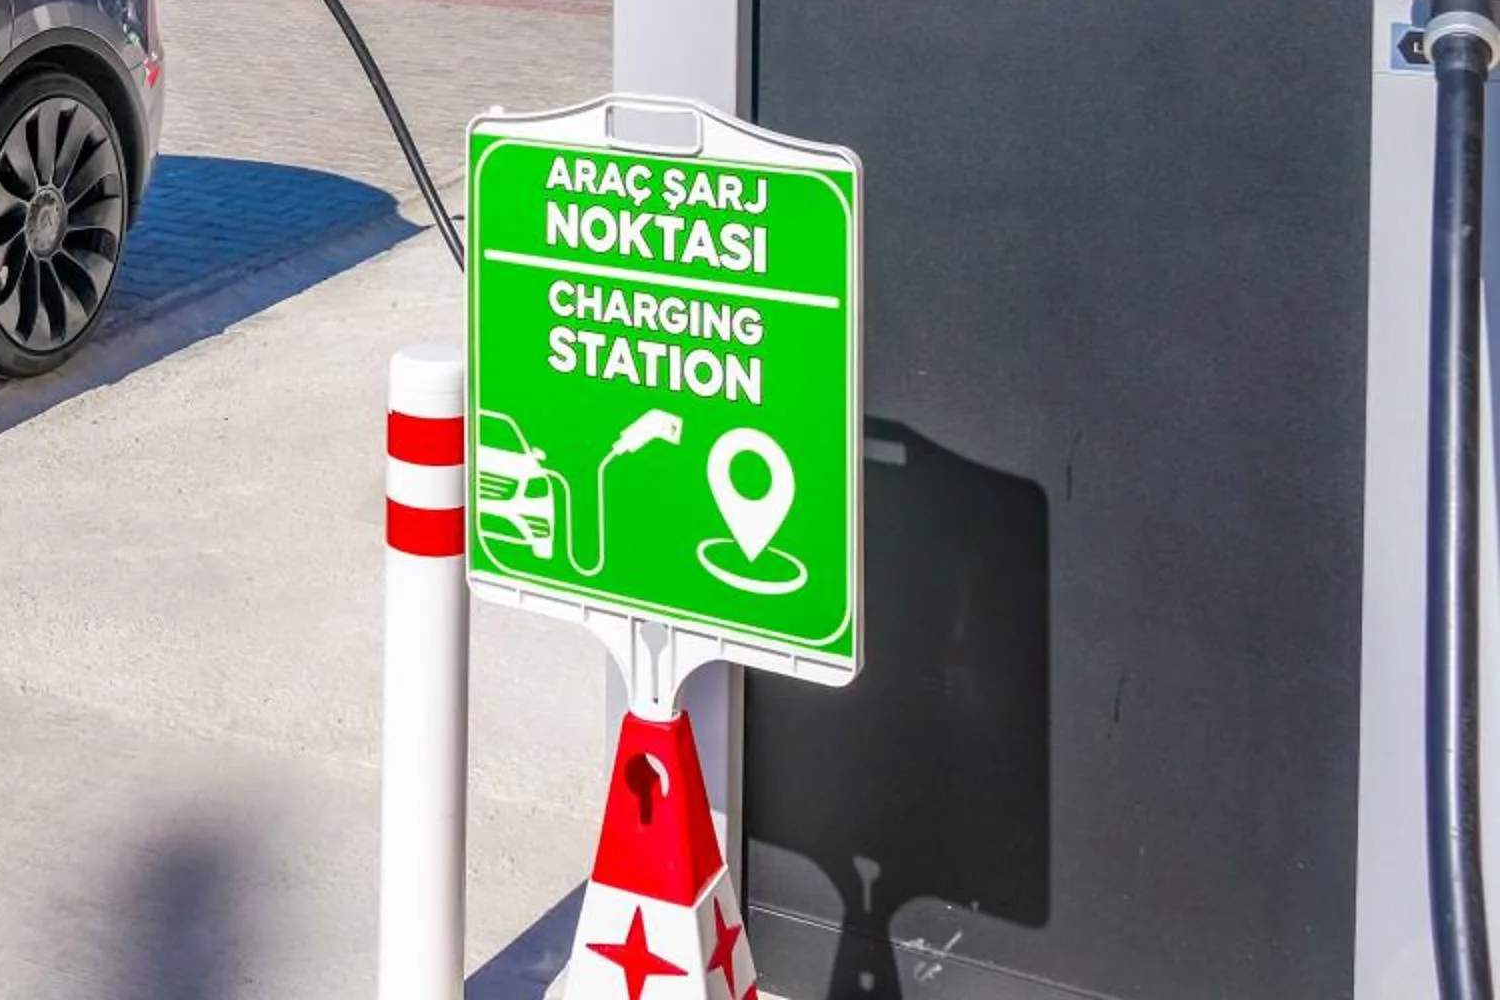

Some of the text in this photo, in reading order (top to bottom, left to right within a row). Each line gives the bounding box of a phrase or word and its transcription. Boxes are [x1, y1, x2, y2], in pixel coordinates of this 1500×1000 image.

[546, 157, 767, 214] ARAÇ ŞARJ
[547, 201, 767, 273] NOKTASI
[548, 280, 763, 345] CHARGING
[547, 326, 761, 405] STATION
